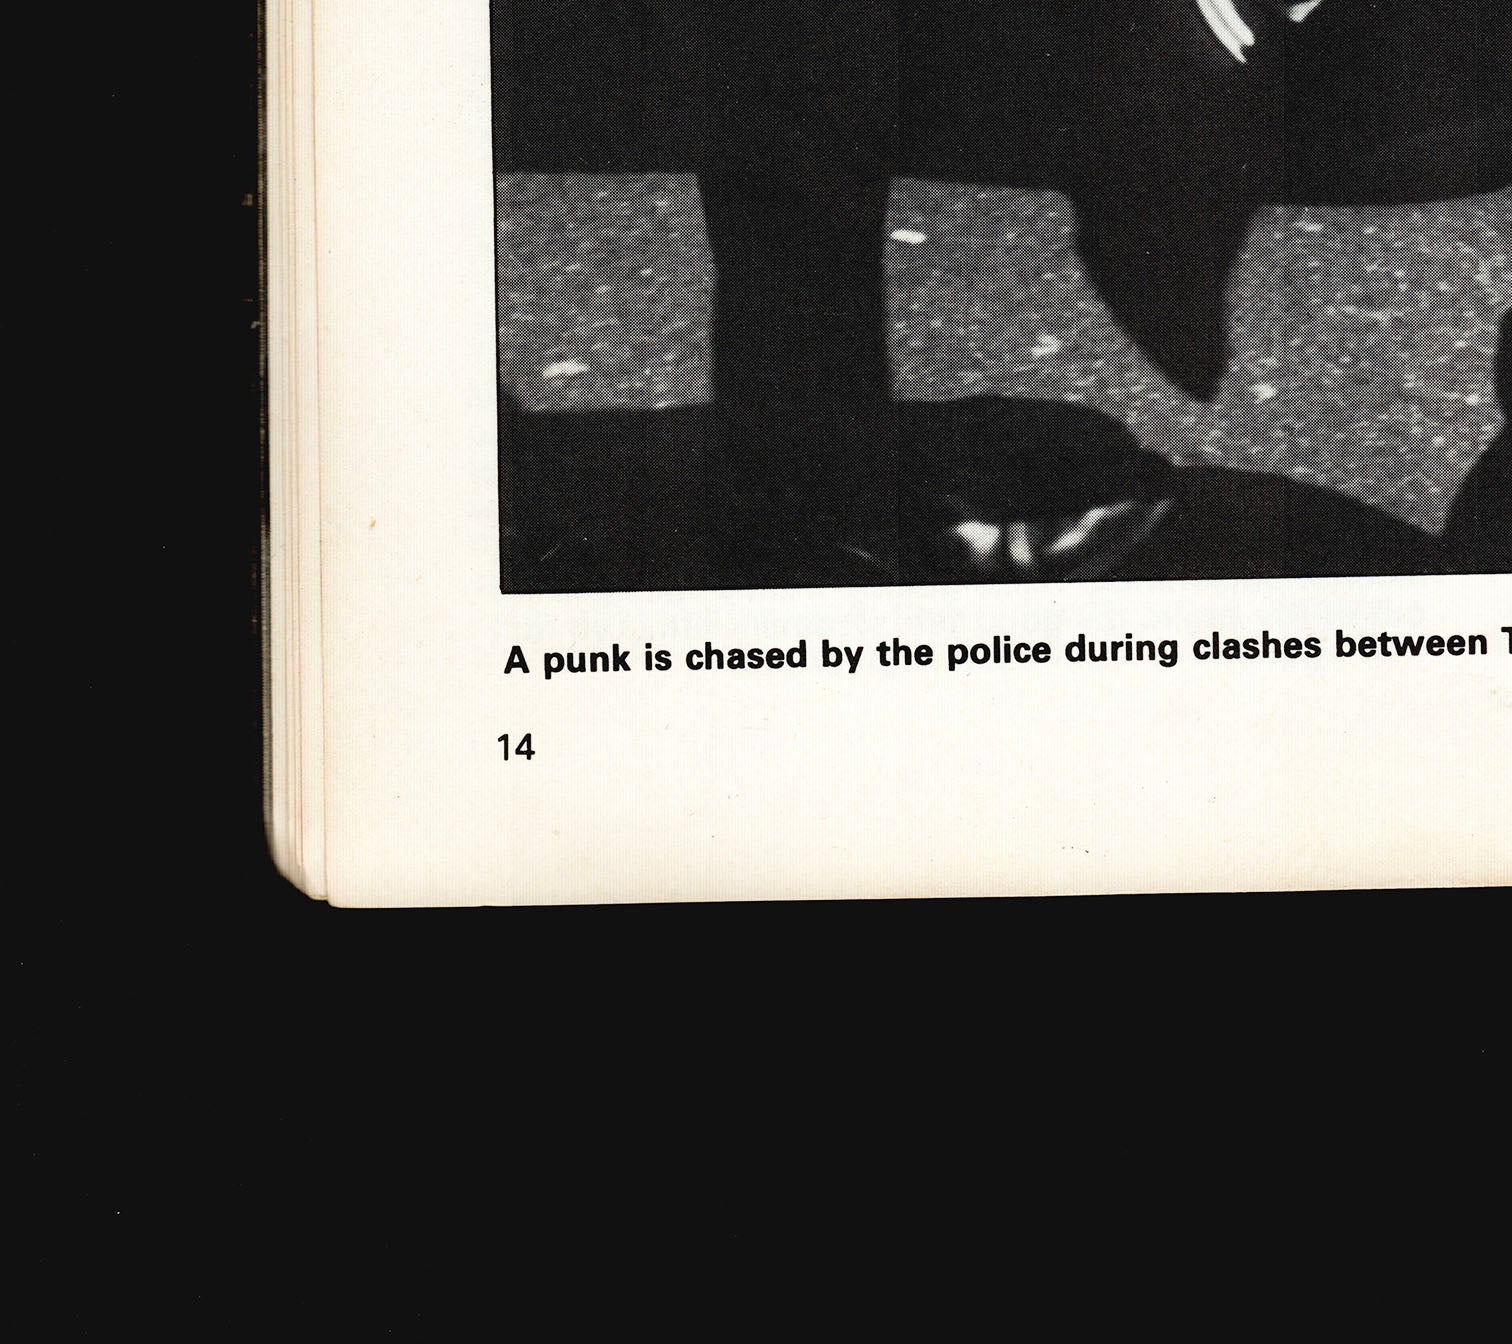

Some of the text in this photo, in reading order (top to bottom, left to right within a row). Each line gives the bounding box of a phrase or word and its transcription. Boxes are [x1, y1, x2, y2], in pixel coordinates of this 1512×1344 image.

[503, 645, 530, 675] A
[543, 643, 632, 680] punk
[645, 642, 672, 671] is
[685, 639, 807, 671] chased
[821, 639, 864, 674] by
[875, 637, 934, 667] the
[947, 635, 1052, 672] police
[1064, 632, 1178, 668] during
[1192, 630, 1322, 661] clashes
[1335, 629, 1488, 658] between
[497, 732, 536, 761] 14
